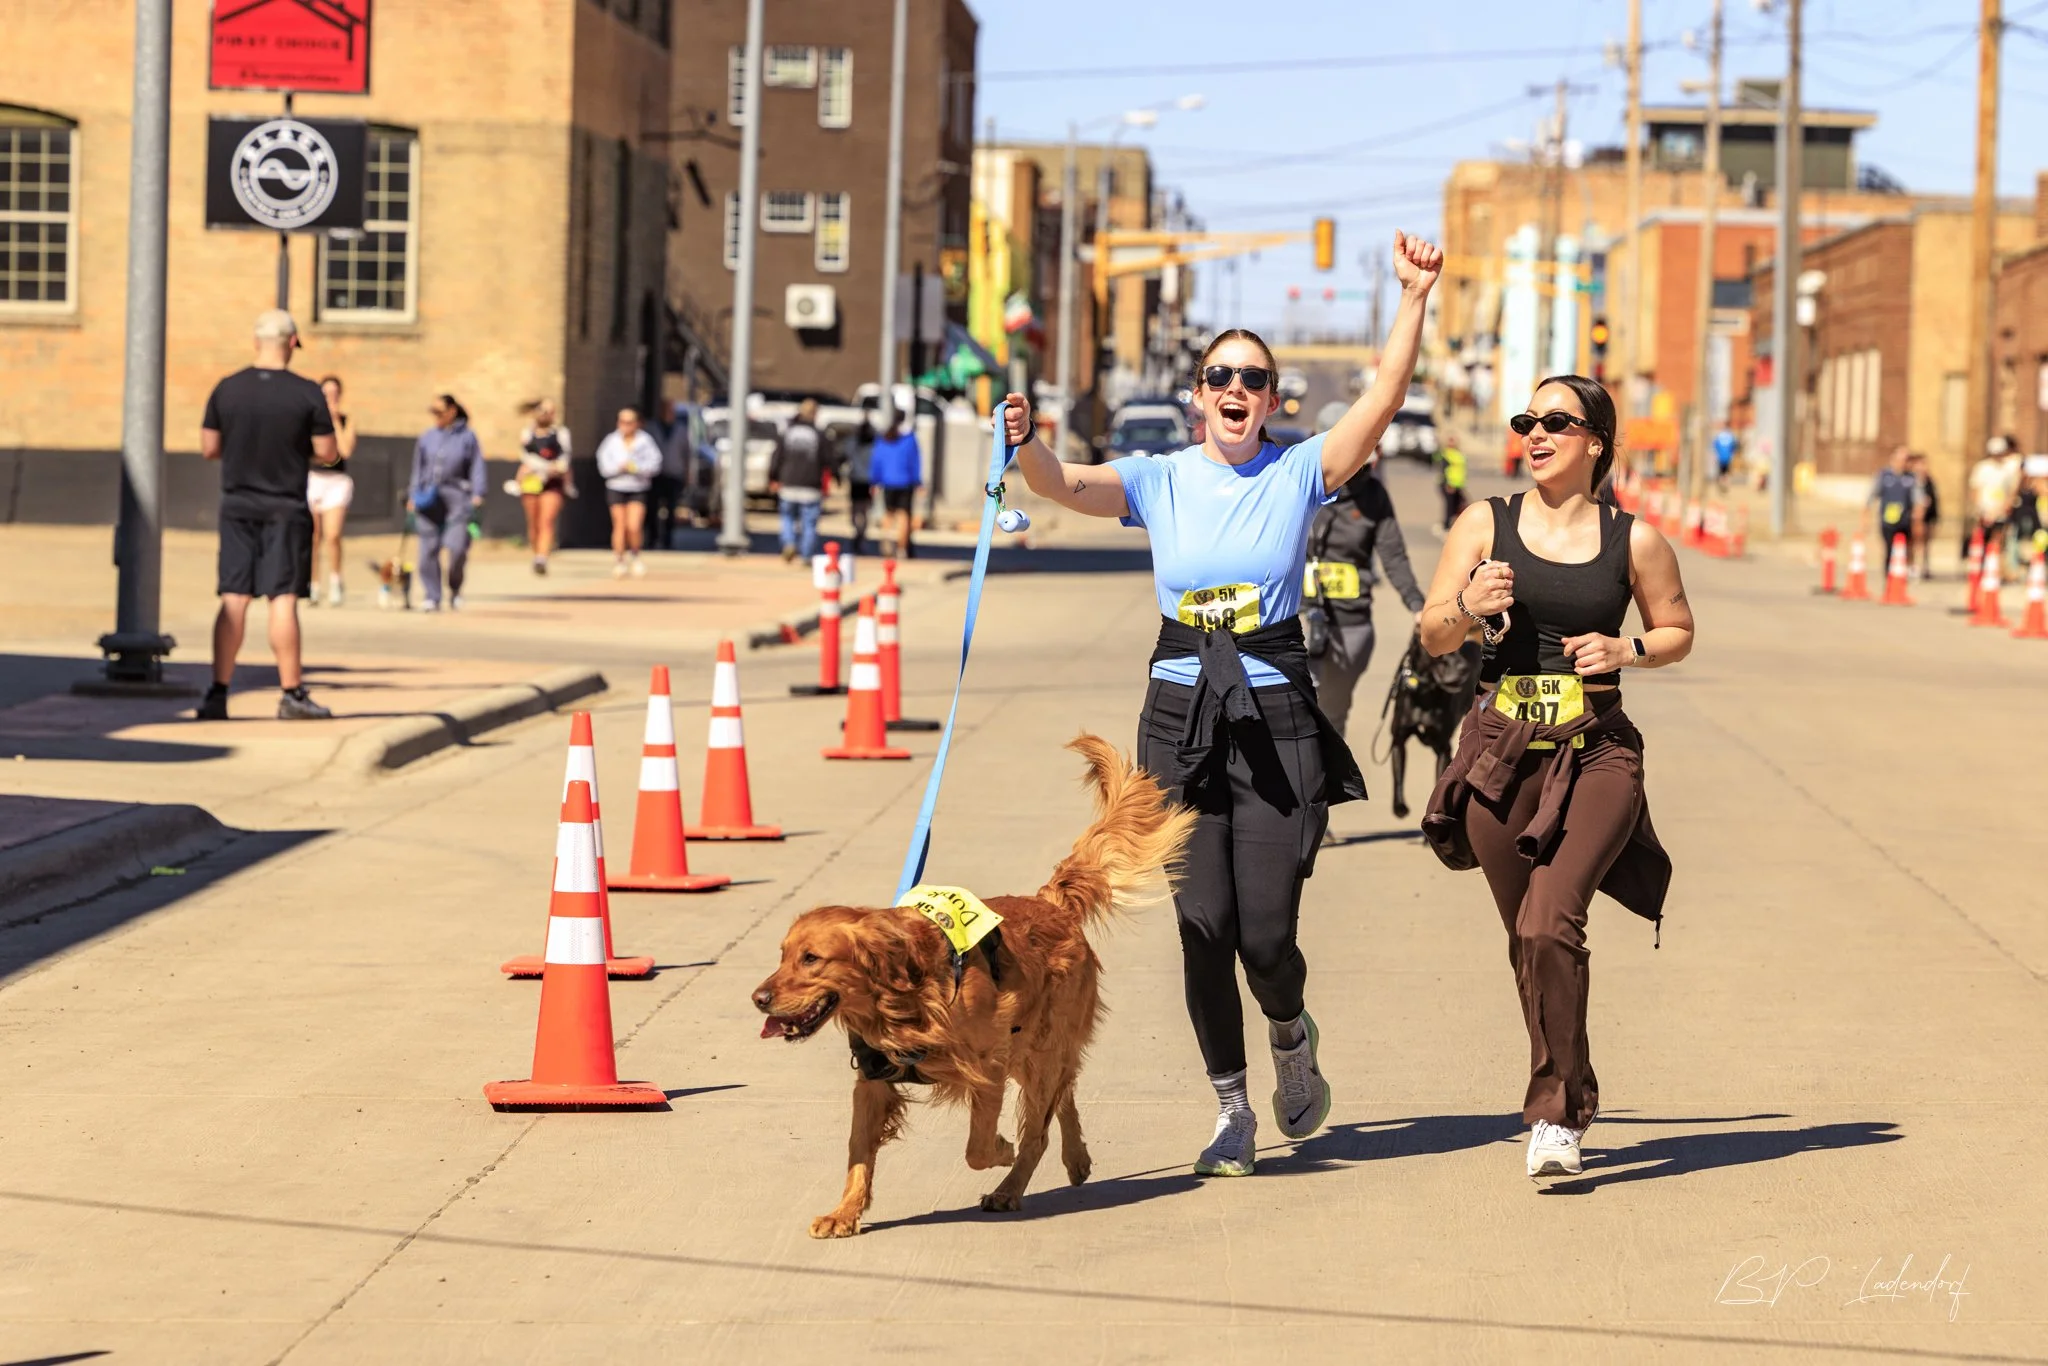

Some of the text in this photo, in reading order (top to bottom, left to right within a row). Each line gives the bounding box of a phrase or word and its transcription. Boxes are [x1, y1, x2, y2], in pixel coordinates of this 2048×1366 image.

[1218, 587, 1237, 602] 5K
[1541, 679, 1561, 695] 5K
[1515, 701, 1560, 726] 497
